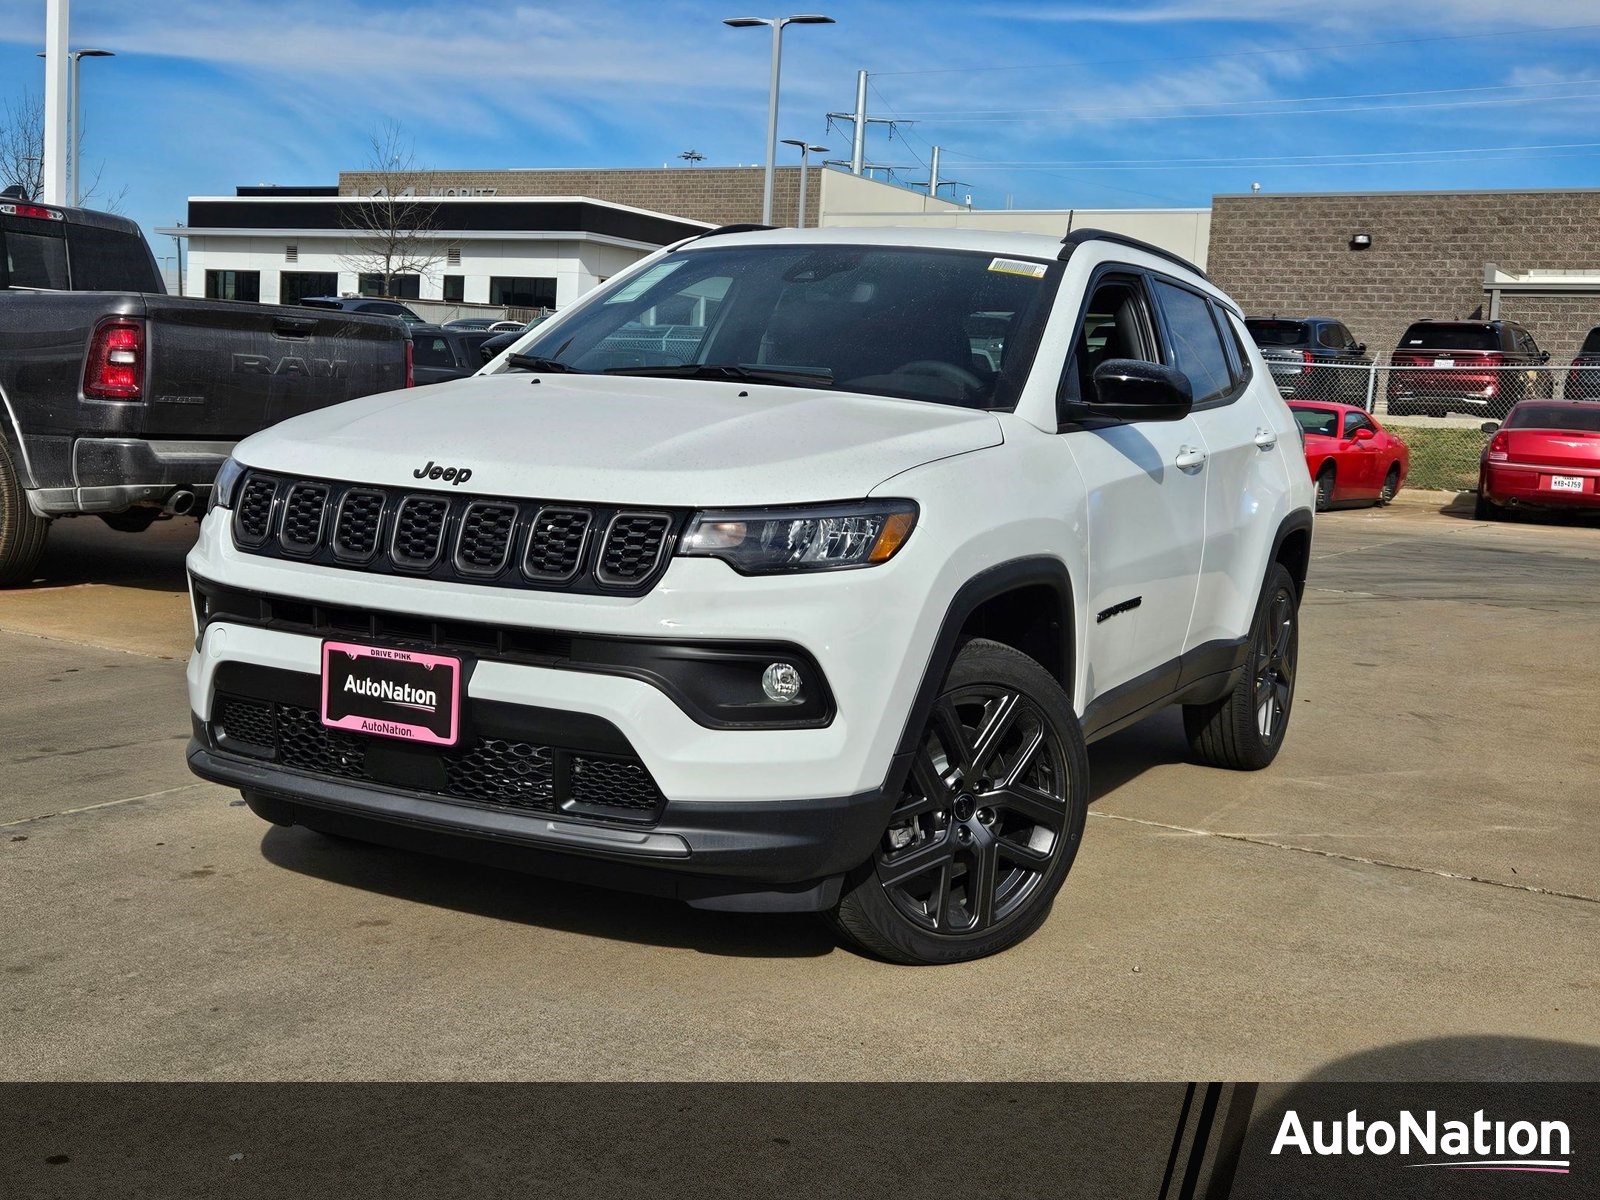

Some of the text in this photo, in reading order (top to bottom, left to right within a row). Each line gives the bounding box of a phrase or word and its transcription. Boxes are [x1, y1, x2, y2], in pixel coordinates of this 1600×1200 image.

[231, 353, 349, 378] RAM
[413, 460, 473, 486] Jeep
[370, 649, 412, 661] DRIVE PINK
[343, 674, 437, 706] AutoNation
[361, 720, 413, 737] AutoNation
